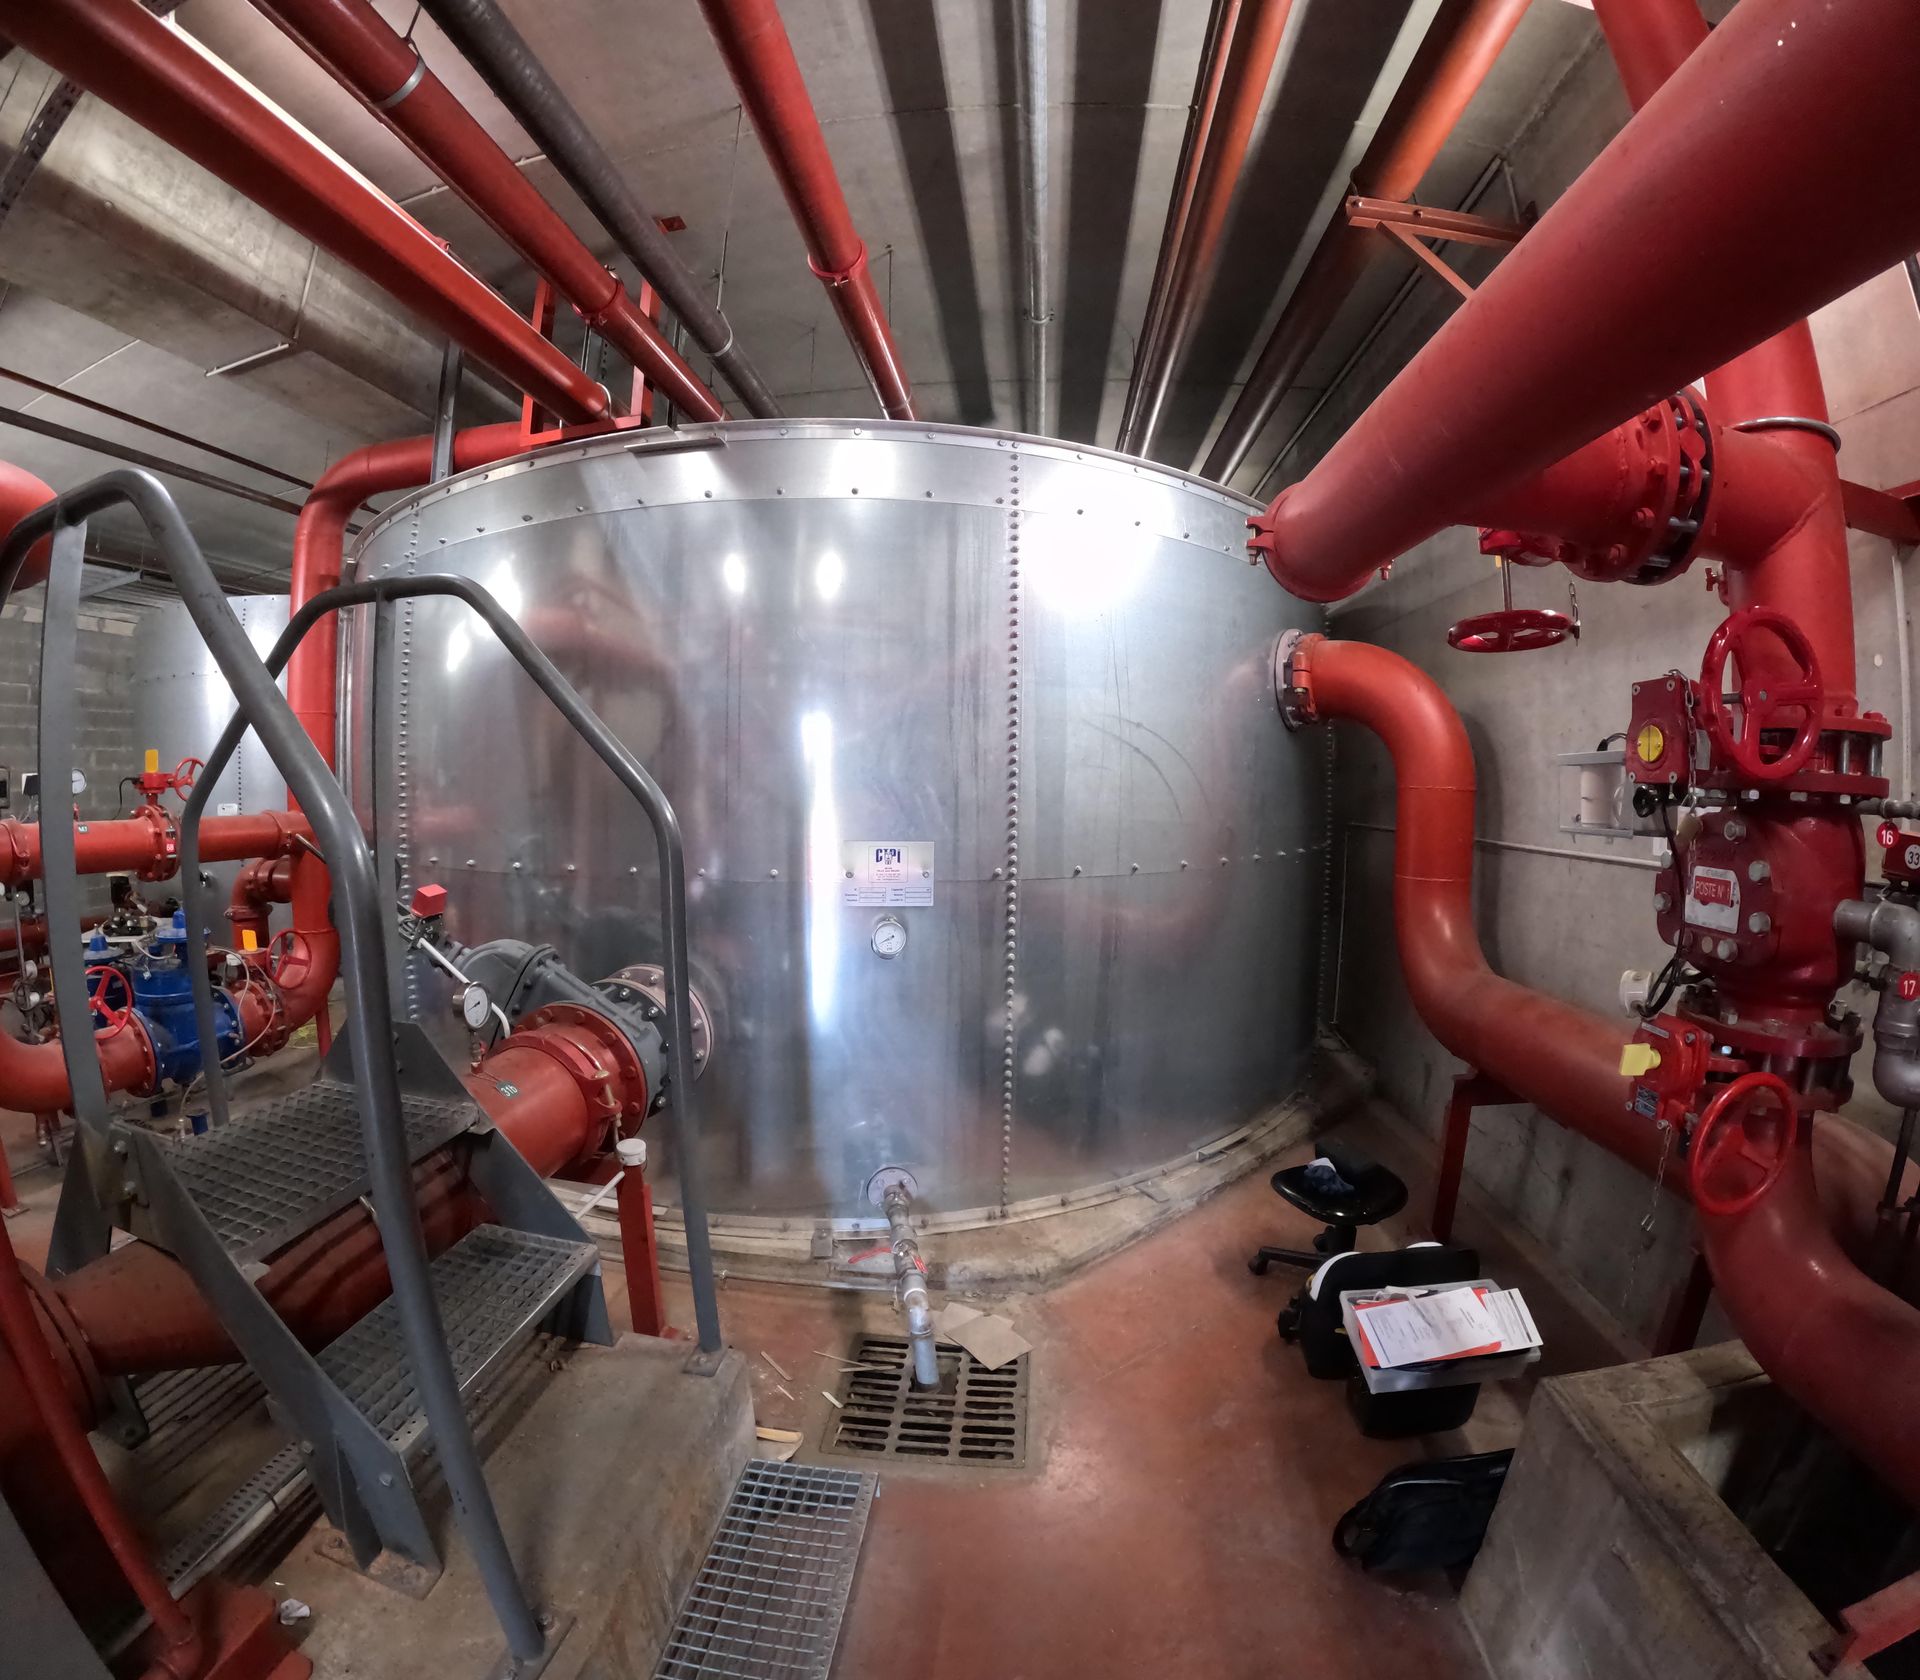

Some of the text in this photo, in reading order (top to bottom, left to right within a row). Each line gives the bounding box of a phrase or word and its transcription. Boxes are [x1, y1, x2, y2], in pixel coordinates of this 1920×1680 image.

[1881, 829, 1893, 845] 16
[1907, 851, 1920, 866] 33
[1695, 880, 1716, 898] POSTE
[1903, 980, 1916, 996] 17
